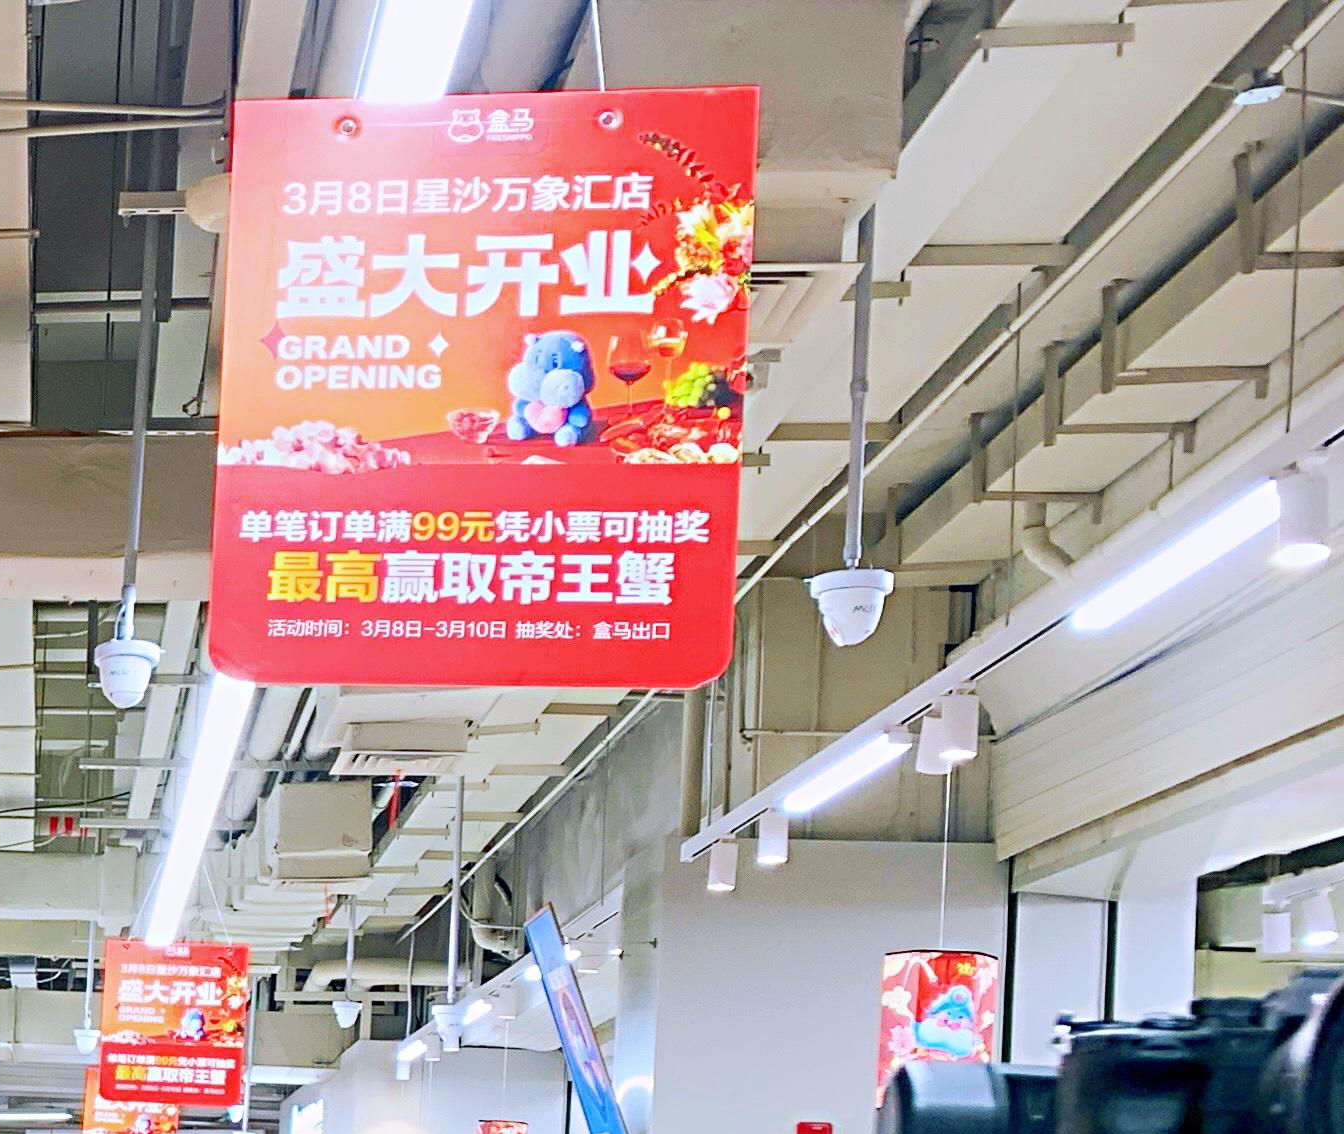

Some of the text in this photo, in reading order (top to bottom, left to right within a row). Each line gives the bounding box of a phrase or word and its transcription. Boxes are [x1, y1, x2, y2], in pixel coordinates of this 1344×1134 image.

[486, 108, 534, 133] 盒马
[282, 173, 654, 216] 3月8日星沙万象汇店
[276, 230, 656, 318] 盛大开业
[277, 334, 410, 360] GRAND
[275, 364, 442, 390] OPENING
[238, 510, 710, 544] 单笔订单满99元凭小票可抽奖
[266, 549, 676, 605] 最高赢取帝王蟹
[117, 978, 222, 1006] 盛大开业
